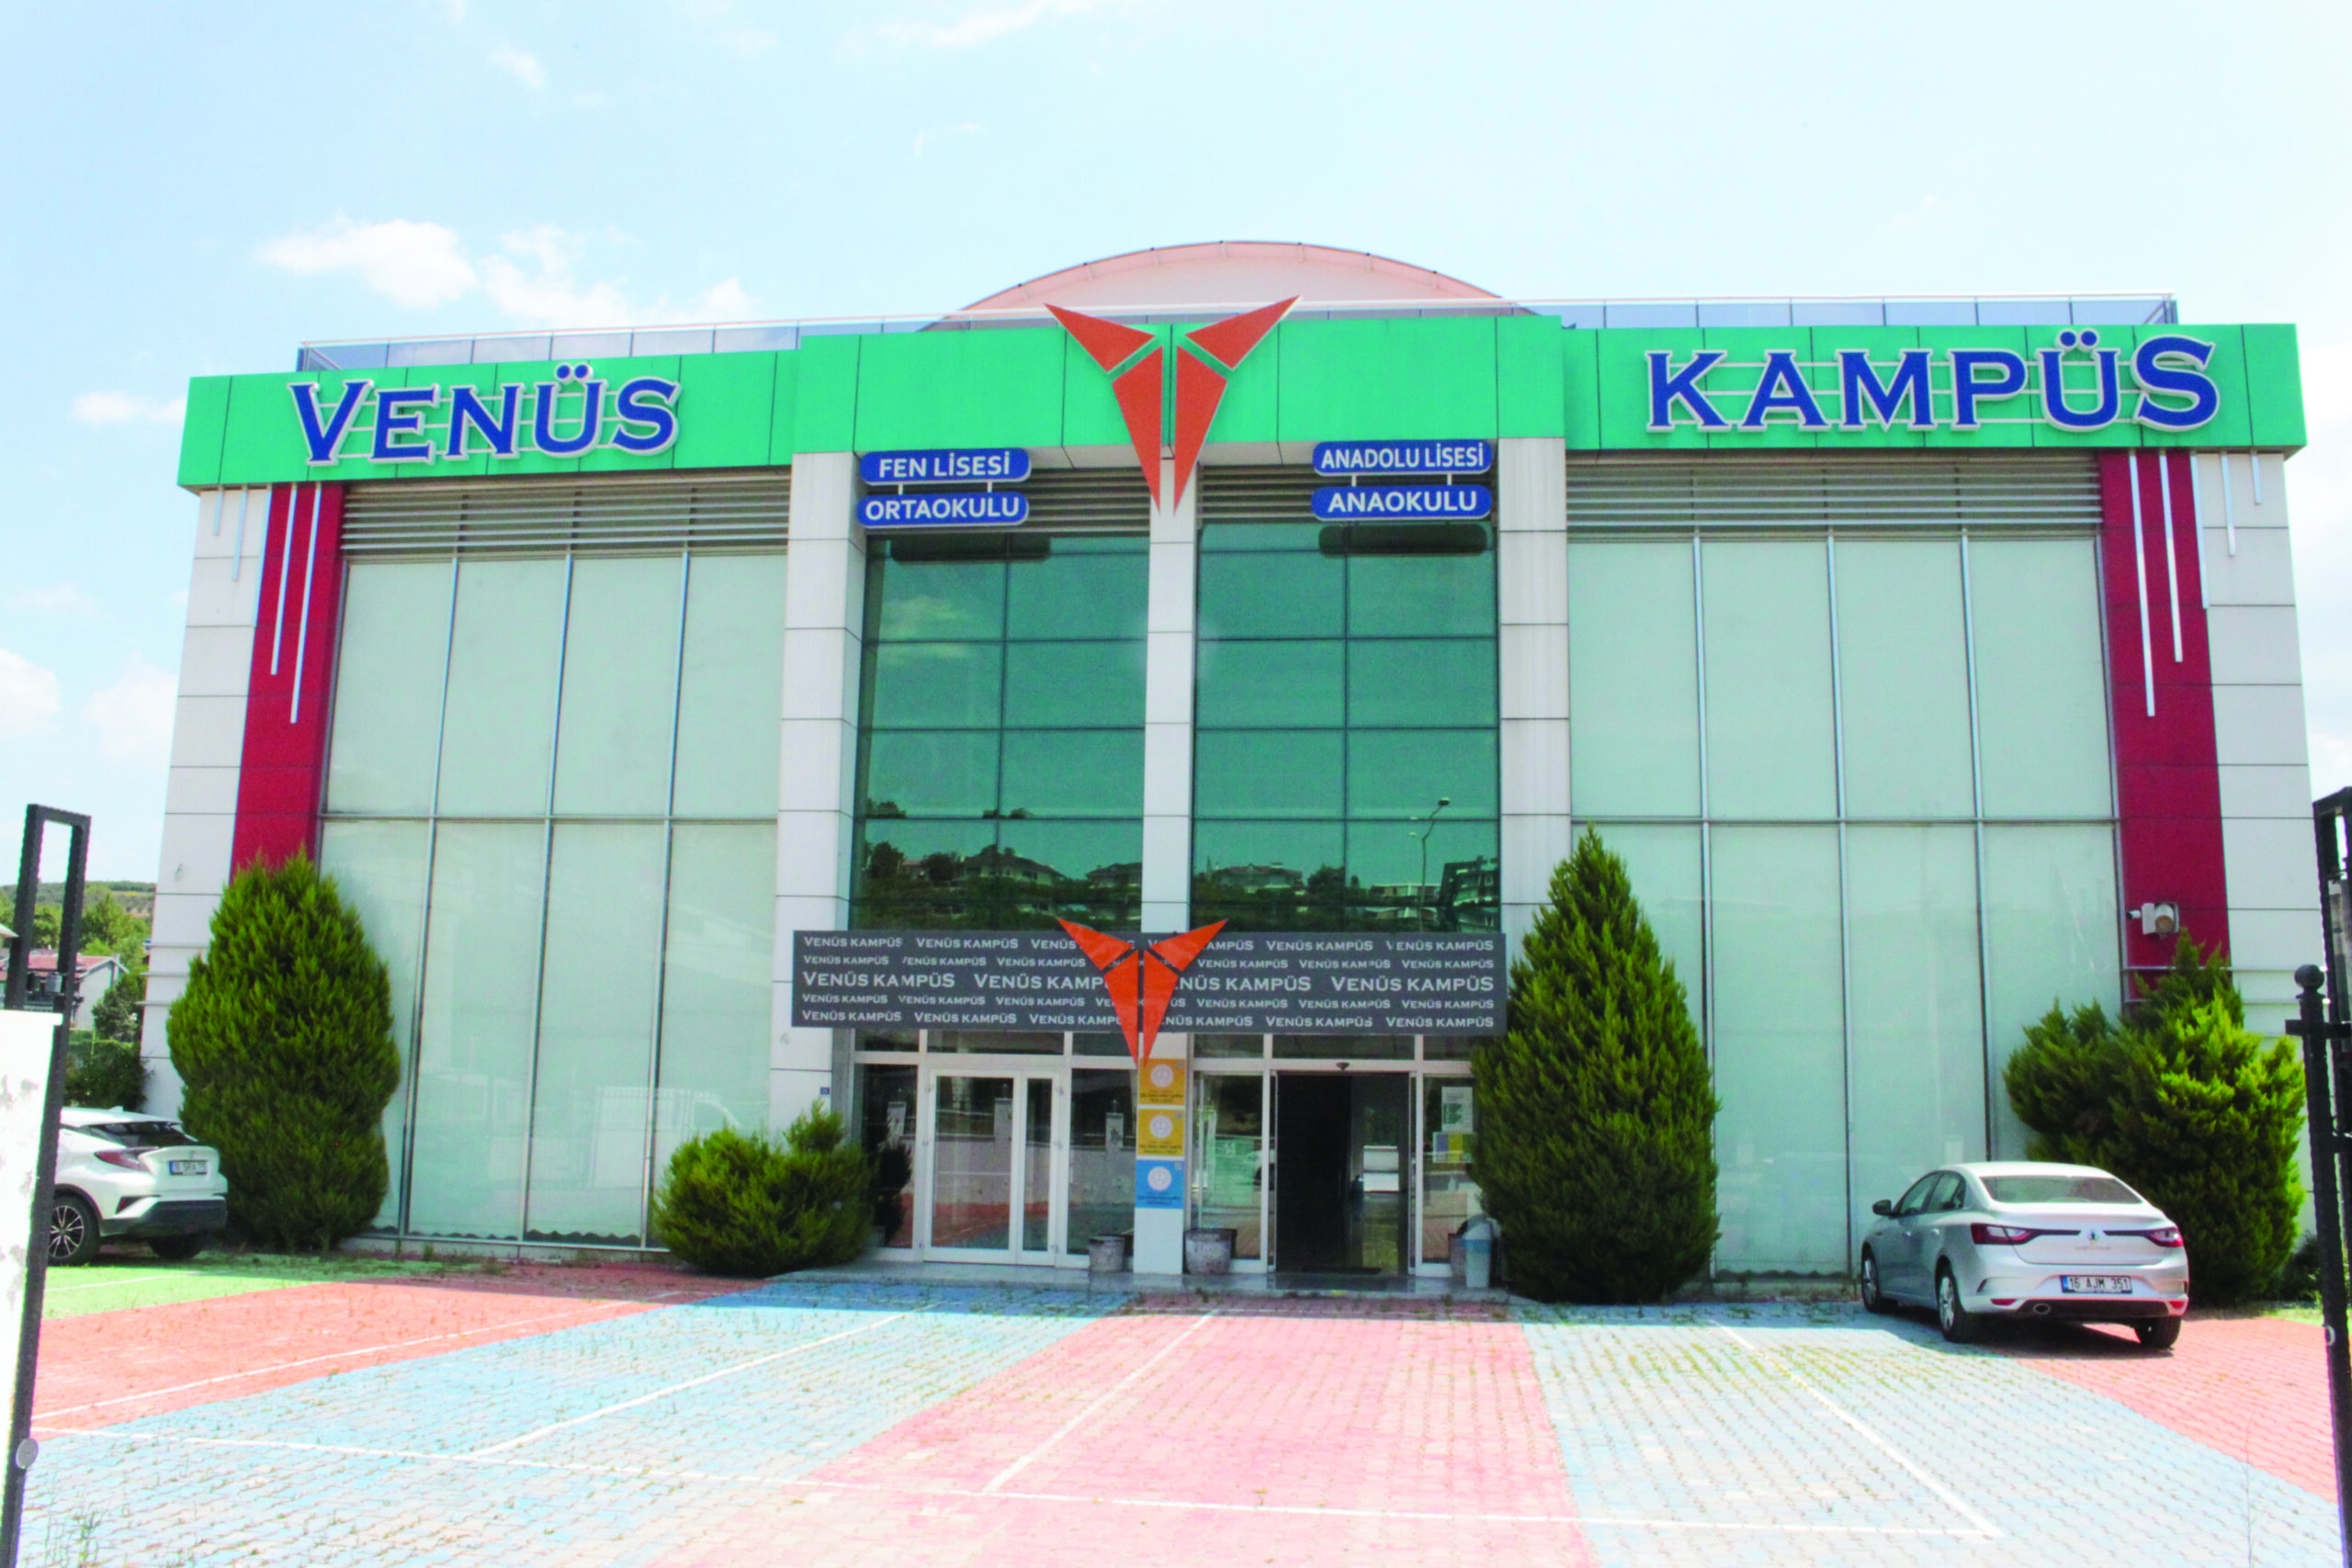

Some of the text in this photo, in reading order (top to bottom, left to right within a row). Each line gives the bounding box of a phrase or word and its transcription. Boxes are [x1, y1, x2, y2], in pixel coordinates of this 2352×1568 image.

[288, 328, 2221, 466] VENÜS KAMPÜS
[879, 452, 1010, 479] FEN LİSESİ
[1321, 443, 1483, 469] ANADOLU LİSESİ
[865, 497, 1019, 521] ORTAOKULU
[1328, 491, 1476, 513] ANAOKULU
[804, 936, 848, 947] VENÜS
[850, 937, 903, 948] KAMPÜS
[916, 937, 961, 948] VENÜS
[964, 938, 1019, 949] KAMPÜS
[1030, 939, 1077, 950] VENÜS
[1204, 940, 1254, 951] AMPÜS
[1266, 941, 1313, 951] VENÜS
[1316, 940, 1374, 951] KAMPÜS
[1385, 940, 1433, 951] VENÜS
[1436, 940, 1494, 951] KAMPÜS
[803, 954, 841, 964] VENÜS
[842, 955, 889, 964] KAMPÜS
[939, 956, 987, 966] KAMPÜS
[996, 957, 1035, 966] VENÜS
[1037, 958, 1086, 967] KAMPÜS
[1197, 958, 1237, 968] VENÜS
[1239, 959, 1288, 968] KAMPÜS
[1299, 959, 1340, 968] VENÜS
[1401, 959, 1442, 968] VENÜS
[1444, 959, 1494, 968] KAMPÜS
[802, 971, 1494, 991] VENÜS KAMPÜS VENÜS KAMP NÜS KAMPÜS VENÜS KAMPÜS
[802, 993, 840, 1003] VENÜS
[842, 994, 888, 1004] KAMPÜS
[898, 995, 936, 1004] VENÜS
[938, 996, 986, 1005] KAMPÜS
[995, 996, 1035, 1006] VENÜS
[1036, 997, 1085, 1007] KAMPÜS
[1196, 998, 1237, 1008] VENÜS
[1238, 998, 1288, 1009] KAMPÜS
[1298, 998, 1339, 1009] VENÜS
[1401, 998, 1442, 1009] VENÜS
[1444, 999, 1494, 1009] KAMPÜS
[802, 1010, 1494, 1027] VENÜS KAMPÜS VENÜS KAMPÜS VENÜS KAMP NÜS KAMPÜS VENÜS KAMPÜS VENÜS KAMPÜS
[2069, 1278, 2128, 1289] 16 AJM 351
